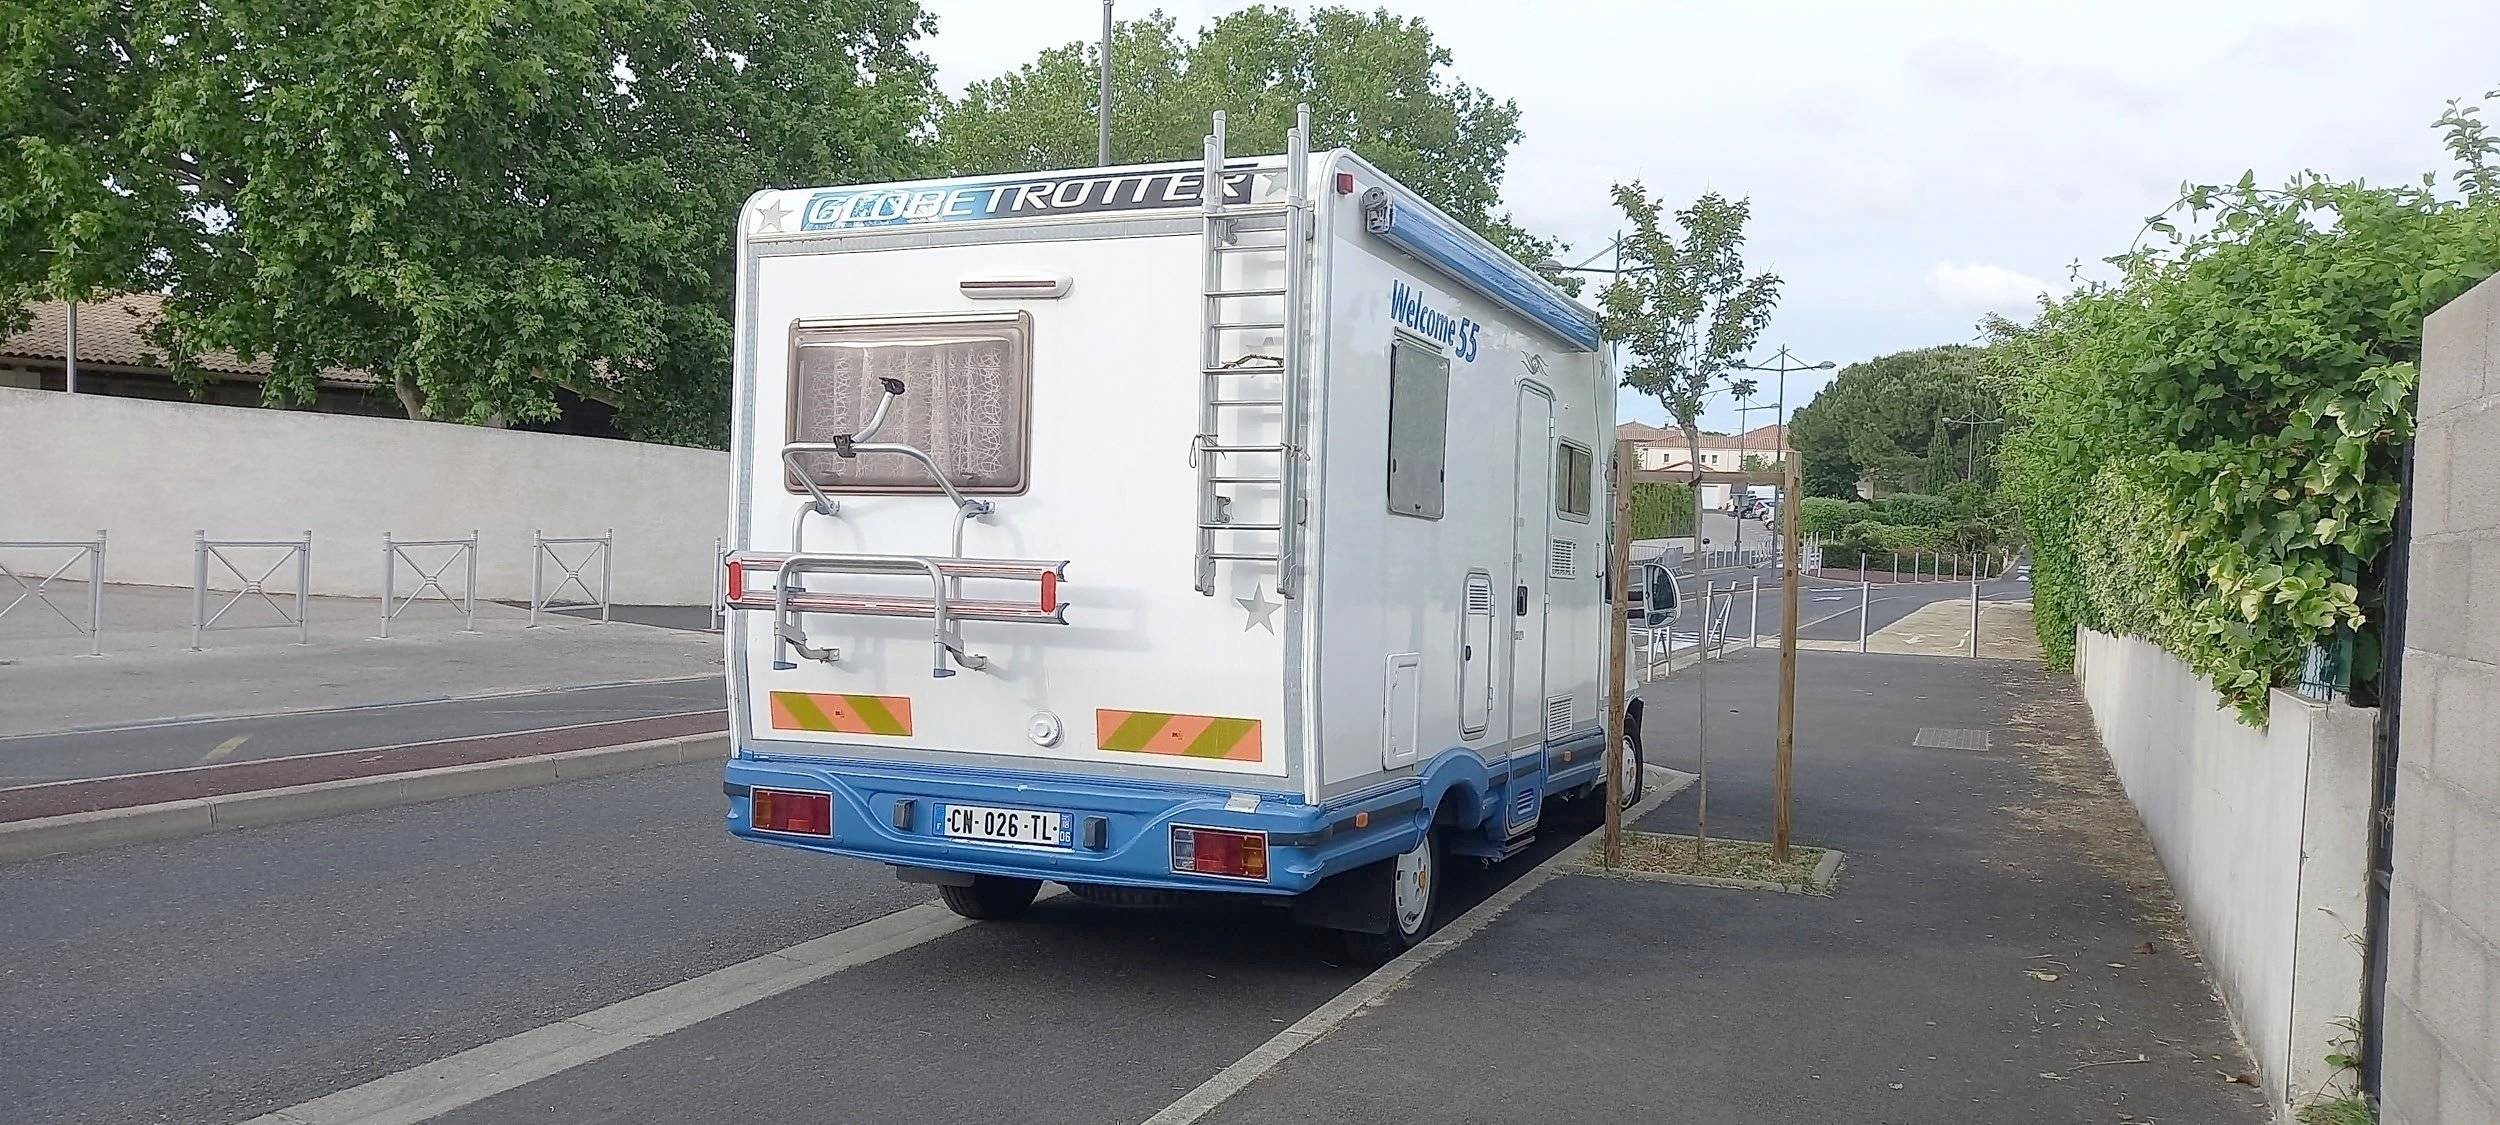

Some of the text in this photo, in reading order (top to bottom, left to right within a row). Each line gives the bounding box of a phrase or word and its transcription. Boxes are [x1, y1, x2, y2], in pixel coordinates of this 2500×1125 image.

[1391, 279, 1480, 363] Welcome 55
[1060, 831, 1071, 843] 06
